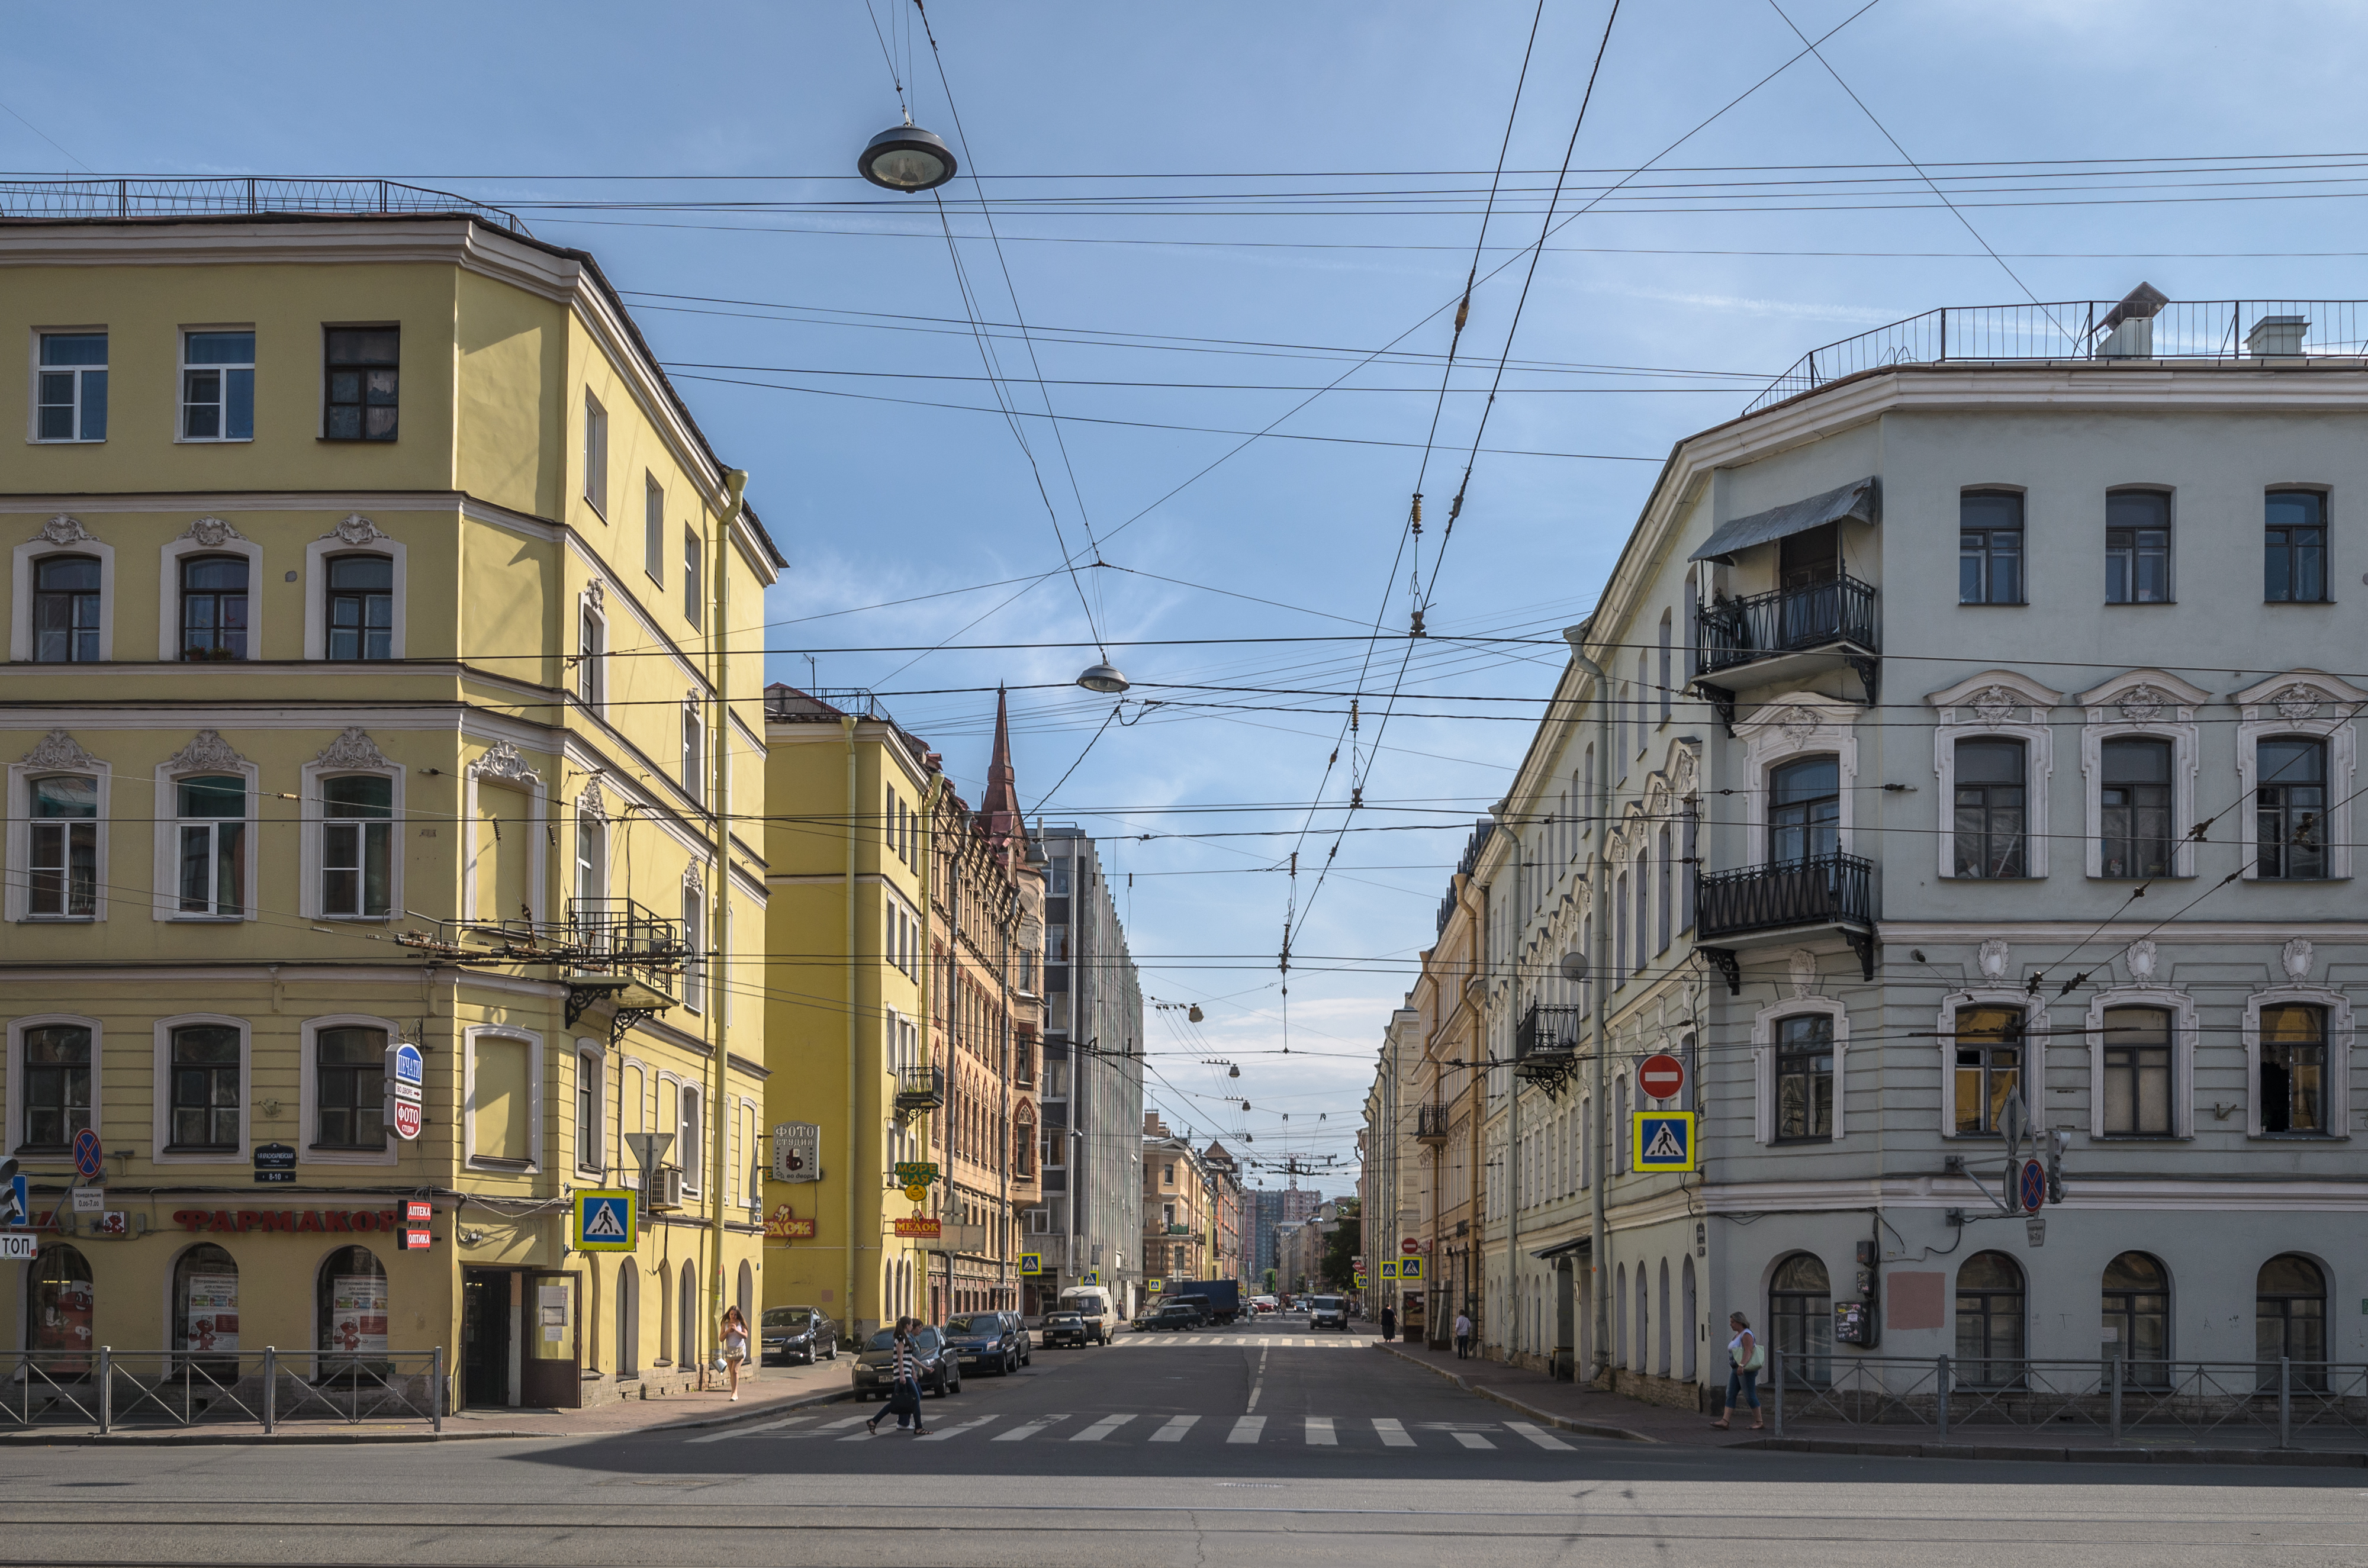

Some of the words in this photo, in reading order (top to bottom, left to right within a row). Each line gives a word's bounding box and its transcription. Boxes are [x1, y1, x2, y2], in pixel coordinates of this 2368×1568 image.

[398, 1054, 421, 1079] ПЕЧАТИ
[402, 1087, 413, 1096] ДВОРЕ
[398, 1105, 419, 1124] ФОТО
[401, 1124, 414, 1134] СТУДИЯ
[775, 1125, 815, 1137] ФОТО
[776, 1138, 814, 1147] СТУДИЯ
[896, 1163, 937, 1174] МОРЕ
[901, 1174, 930, 1184] ЧАЯ
[408, 1206, 431, 1218] АПТЕКА
[173, 1210, 398, 1232] ФАРМАКОР
[896, 1222, 940, 1232] МЕДОК
[763, 1222, 811, 1236] ДОК
[408, 1232, 430, 1244] ОПТИКА
